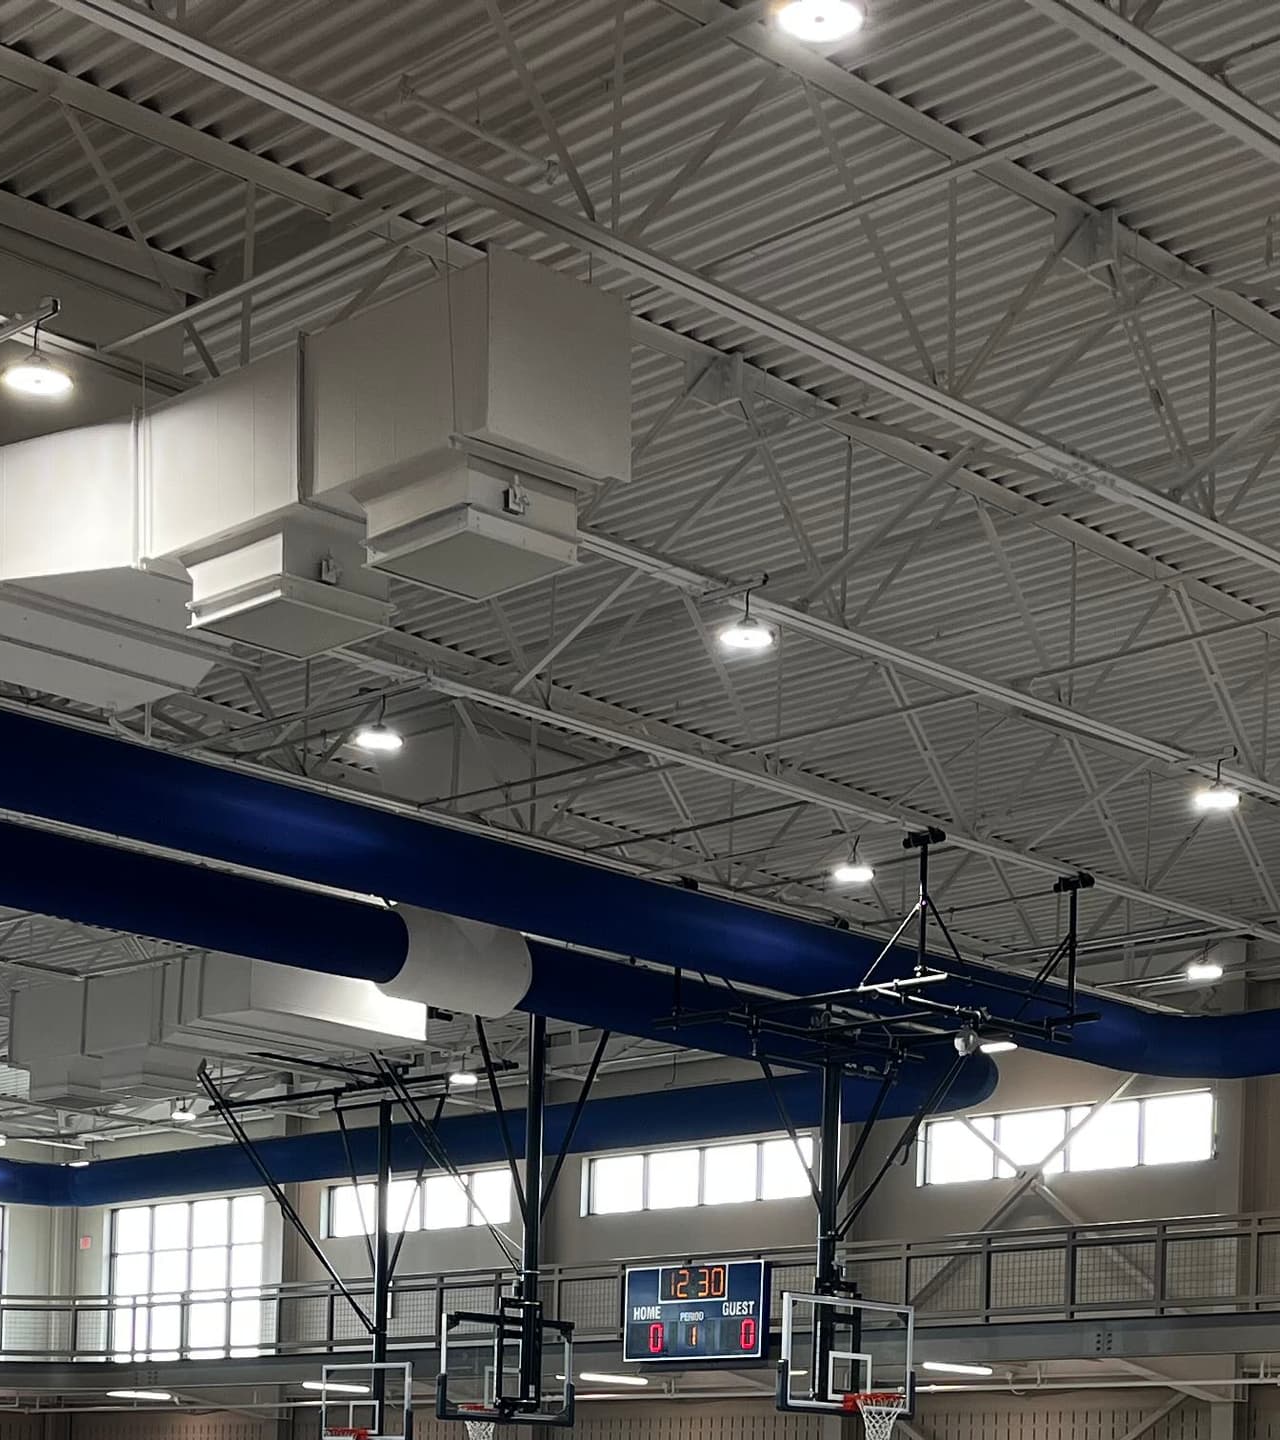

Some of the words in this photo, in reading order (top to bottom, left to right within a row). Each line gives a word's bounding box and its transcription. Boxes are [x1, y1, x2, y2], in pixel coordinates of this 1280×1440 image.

[633, 1306, 661, 1321] HOME
[679, 1311, 705, 1322] PERIOD
[722, 1301, 755, 1316] GUEST
[648, 1322, 664, 1353] 0
[690, 1325, 697, 1346] 1
[740, 1317, 756, 1350] 0
